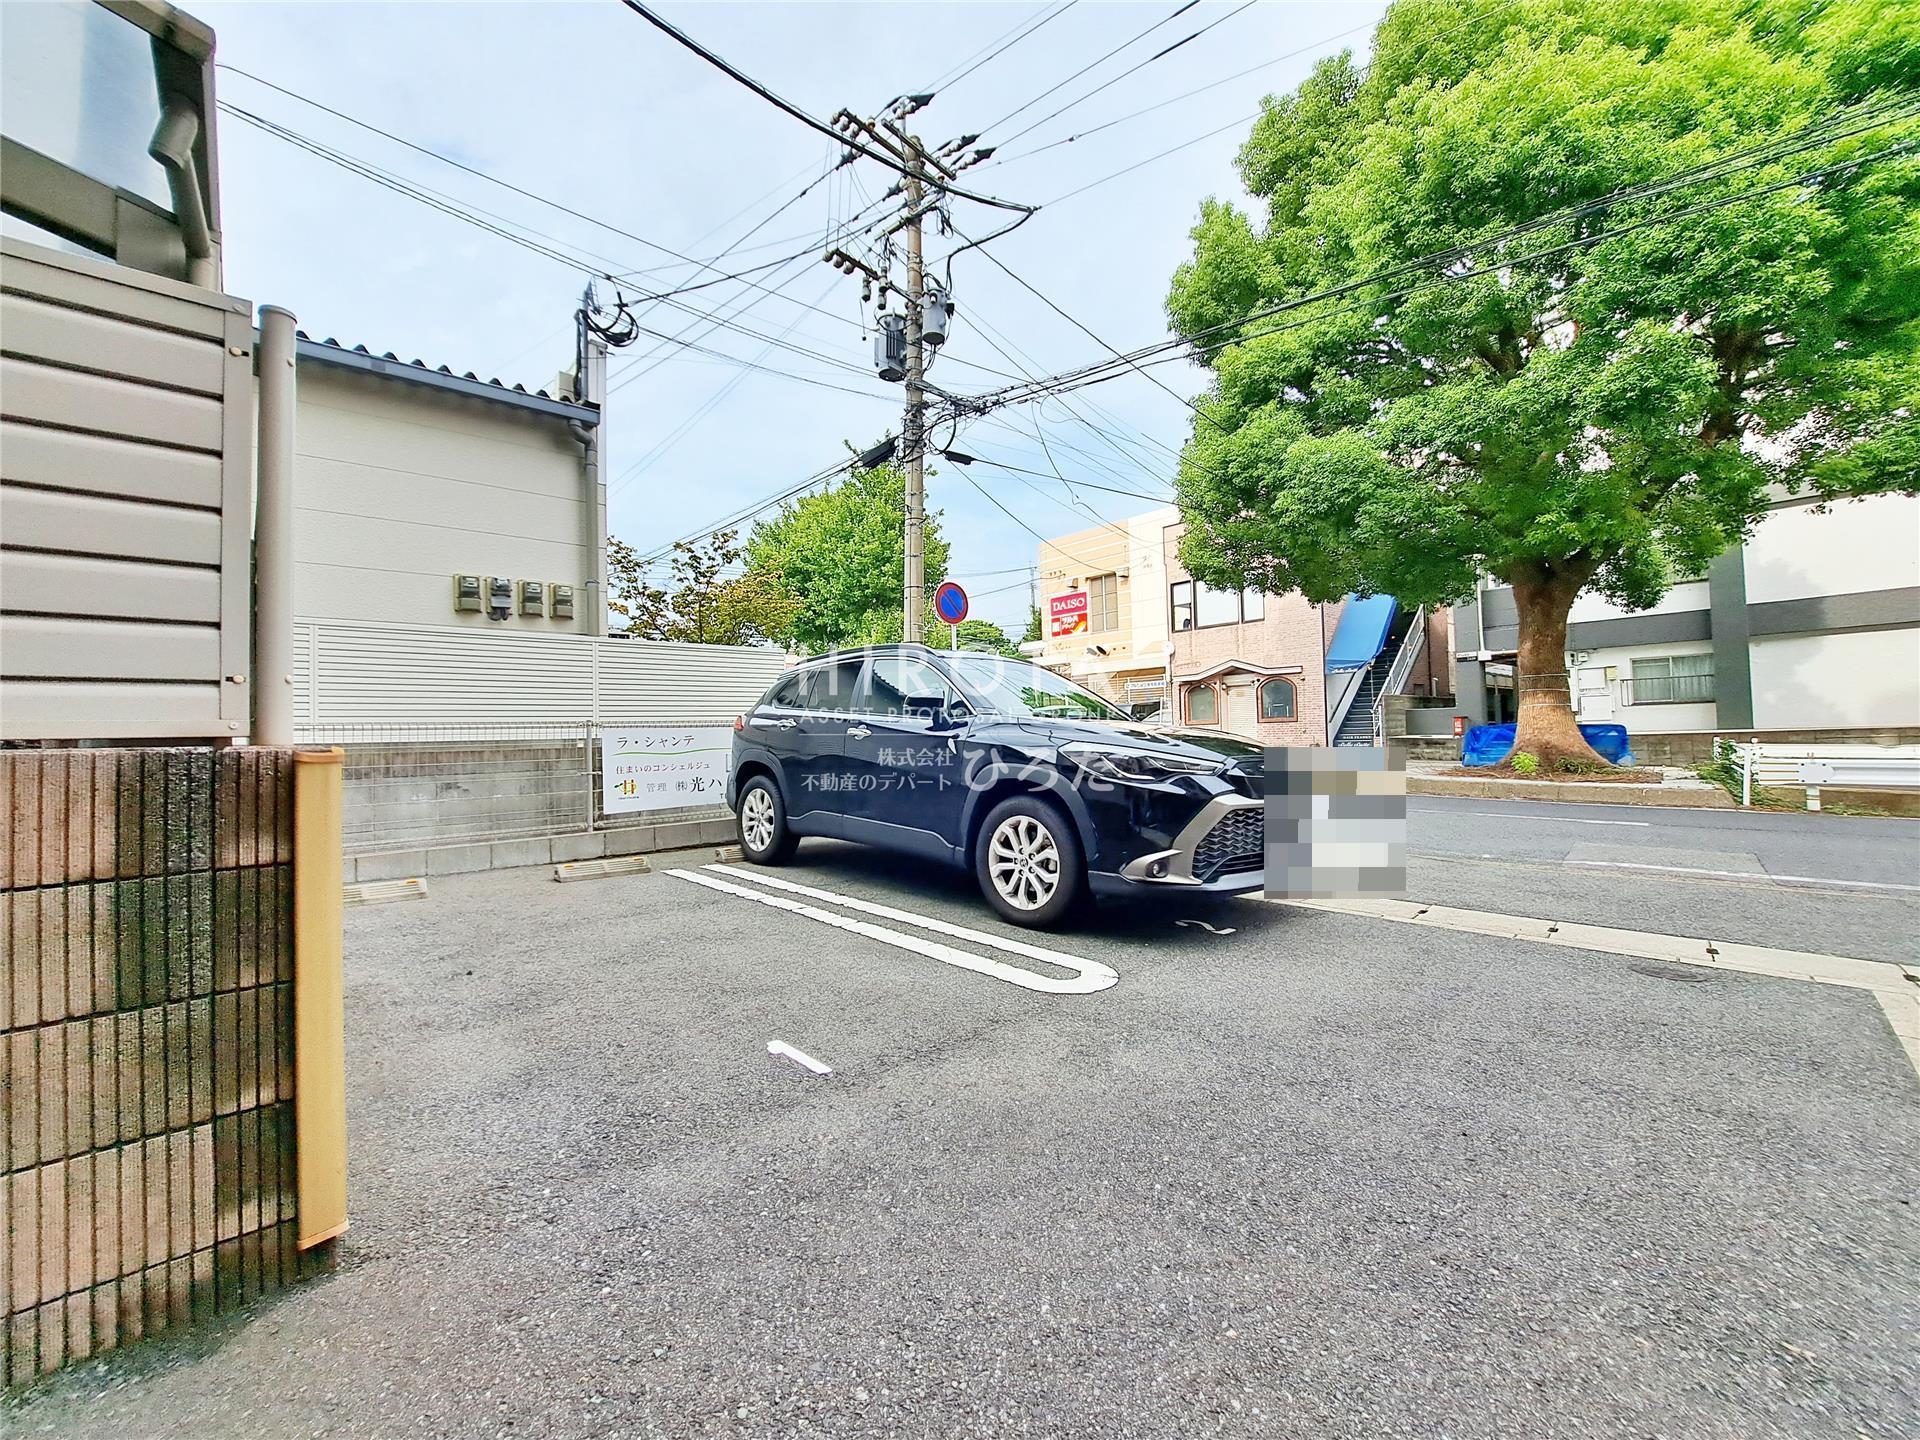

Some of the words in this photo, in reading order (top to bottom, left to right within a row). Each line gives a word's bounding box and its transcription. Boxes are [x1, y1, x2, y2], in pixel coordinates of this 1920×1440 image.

[1053, 597, 1085, 611] DAISO
[617, 735, 695, 749] ラ・シャンテ
[616, 762, 710, 774] 住まいのコンシェルジュ
